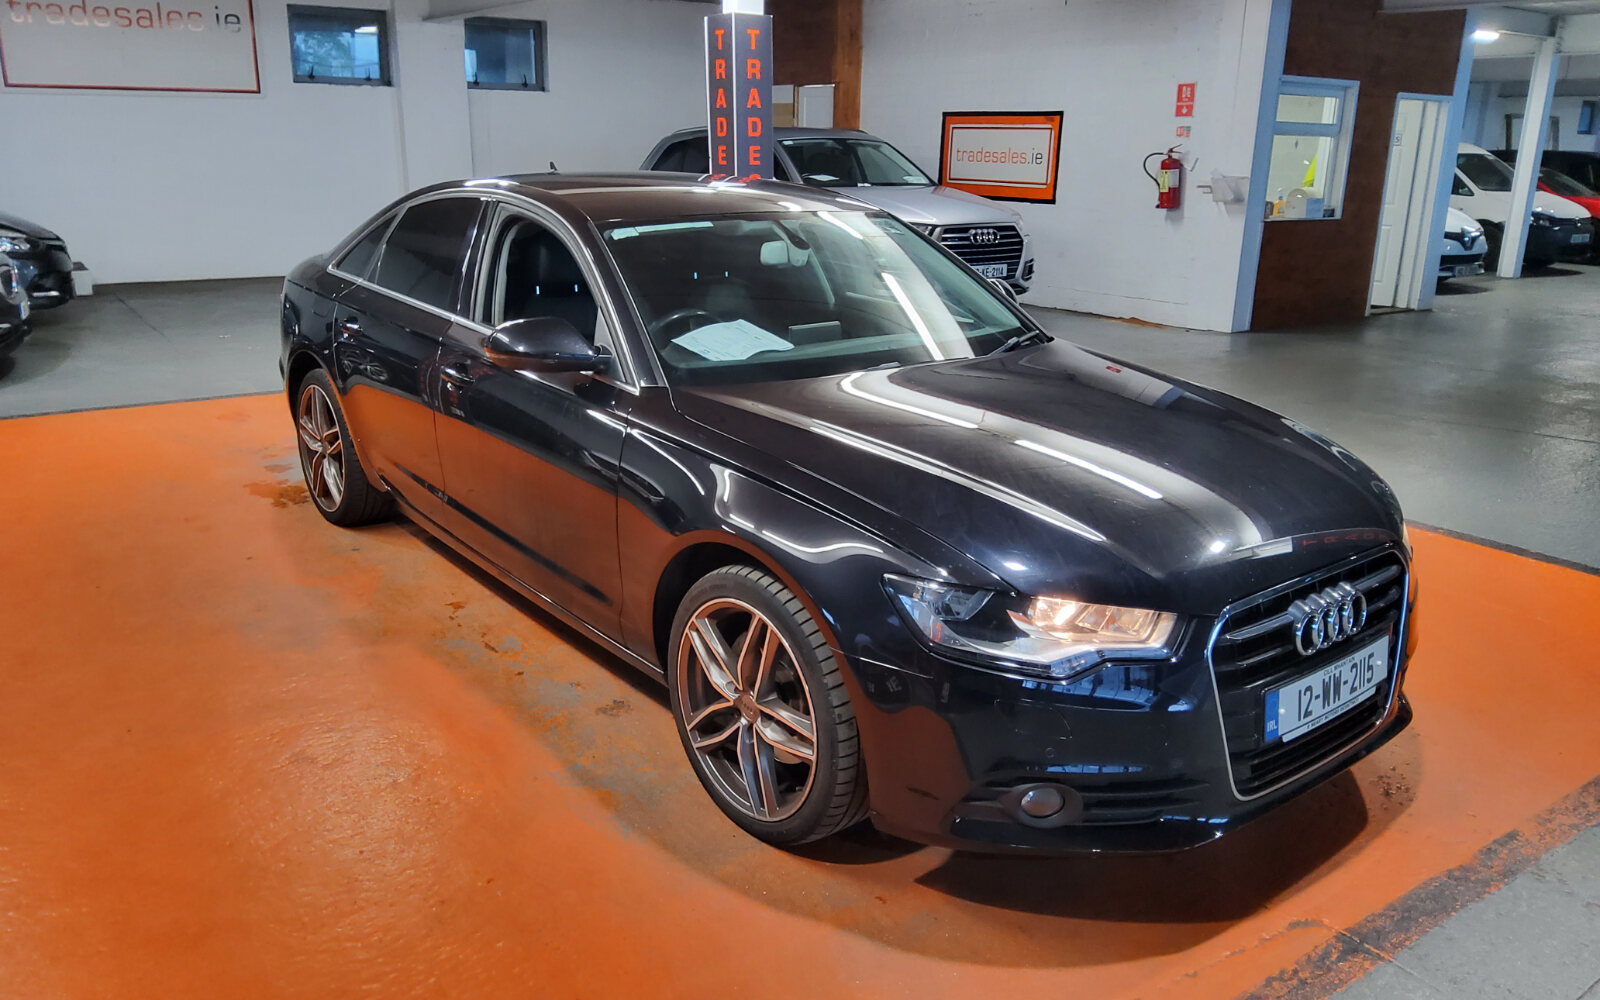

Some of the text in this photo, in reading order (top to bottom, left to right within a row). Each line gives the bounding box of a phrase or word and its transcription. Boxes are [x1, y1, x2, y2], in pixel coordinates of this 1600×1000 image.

[8, 0, 241, 33] tradesalesie
[747, 29, 762, 179] TRADE
[956, 147, 1043, 165] tradesales.ie
[1298, 652, 1374, 721] 12-WW-2115
[1267, 719, 1278, 732] IRL
